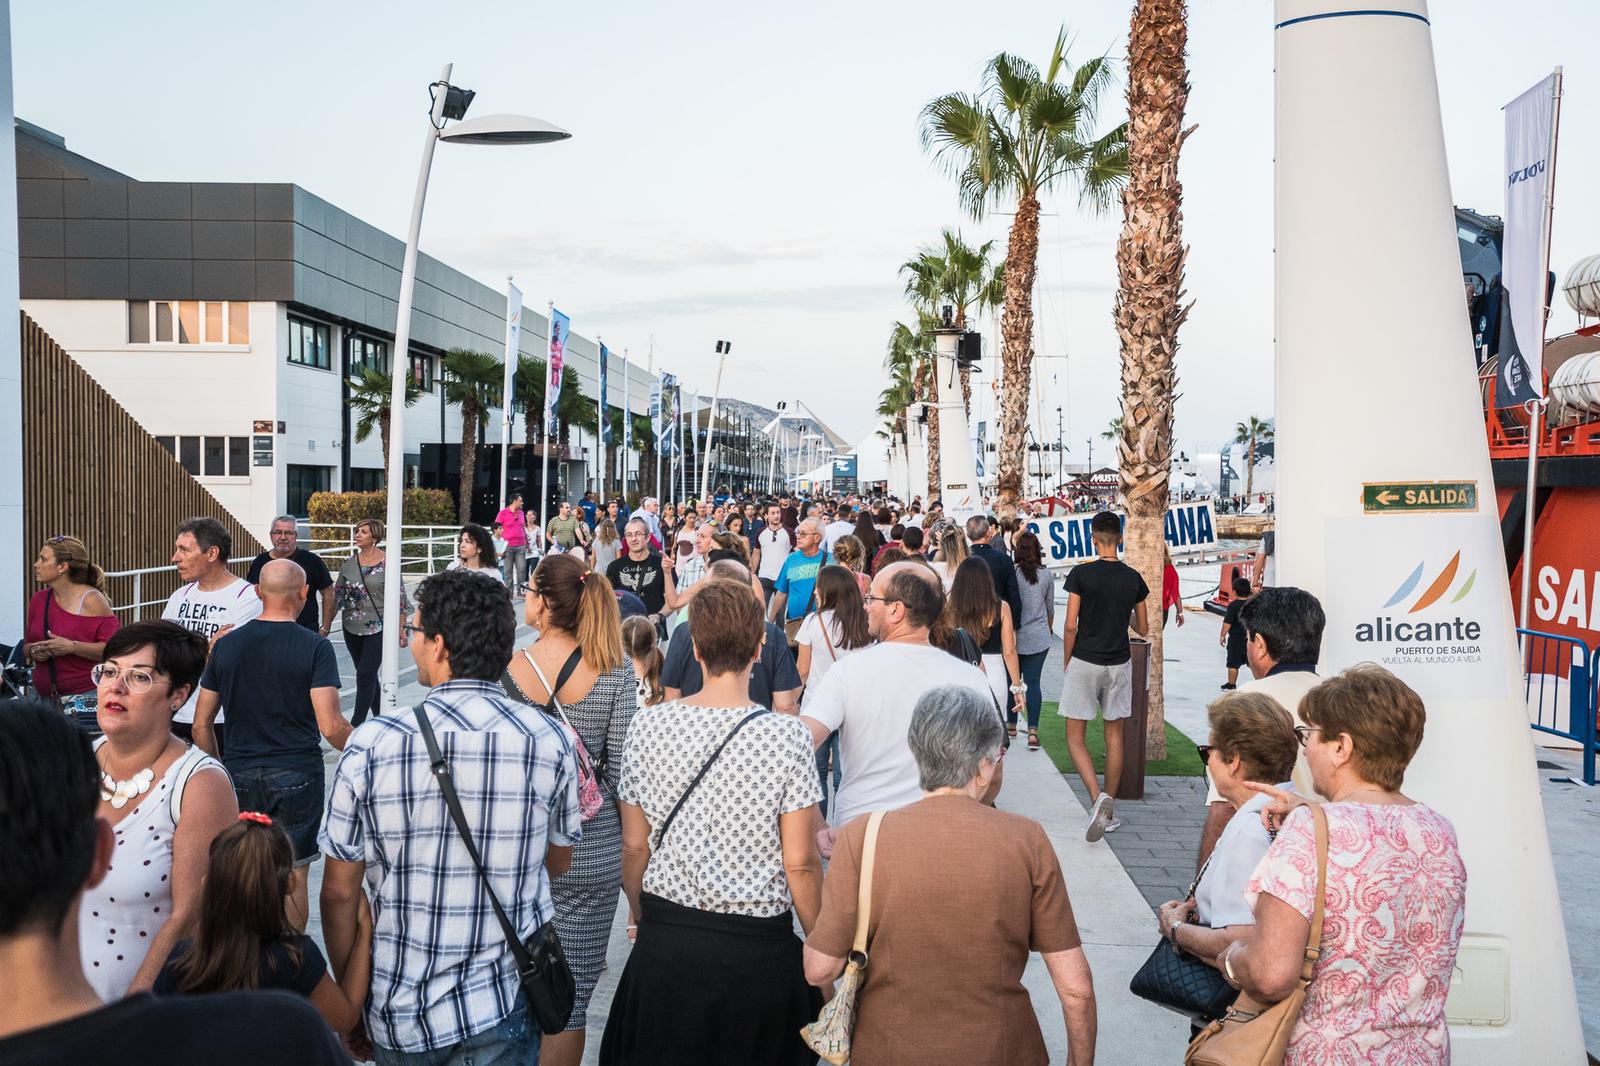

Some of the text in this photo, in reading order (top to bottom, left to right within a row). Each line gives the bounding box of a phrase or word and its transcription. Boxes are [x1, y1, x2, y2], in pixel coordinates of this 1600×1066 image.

[1405, 489, 1468, 504] SALIDA
[178, 603, 227, 620] PLEA
[1355, 617, 1481, 642] alicante
[1395, 646, 1480, 655] PUERTO DE SALIDA
[1414, 656, 1423, 664] AL
[1426, 656, 1455, 664] MUNDO
[1465, 655, 1481, 663] VELA
